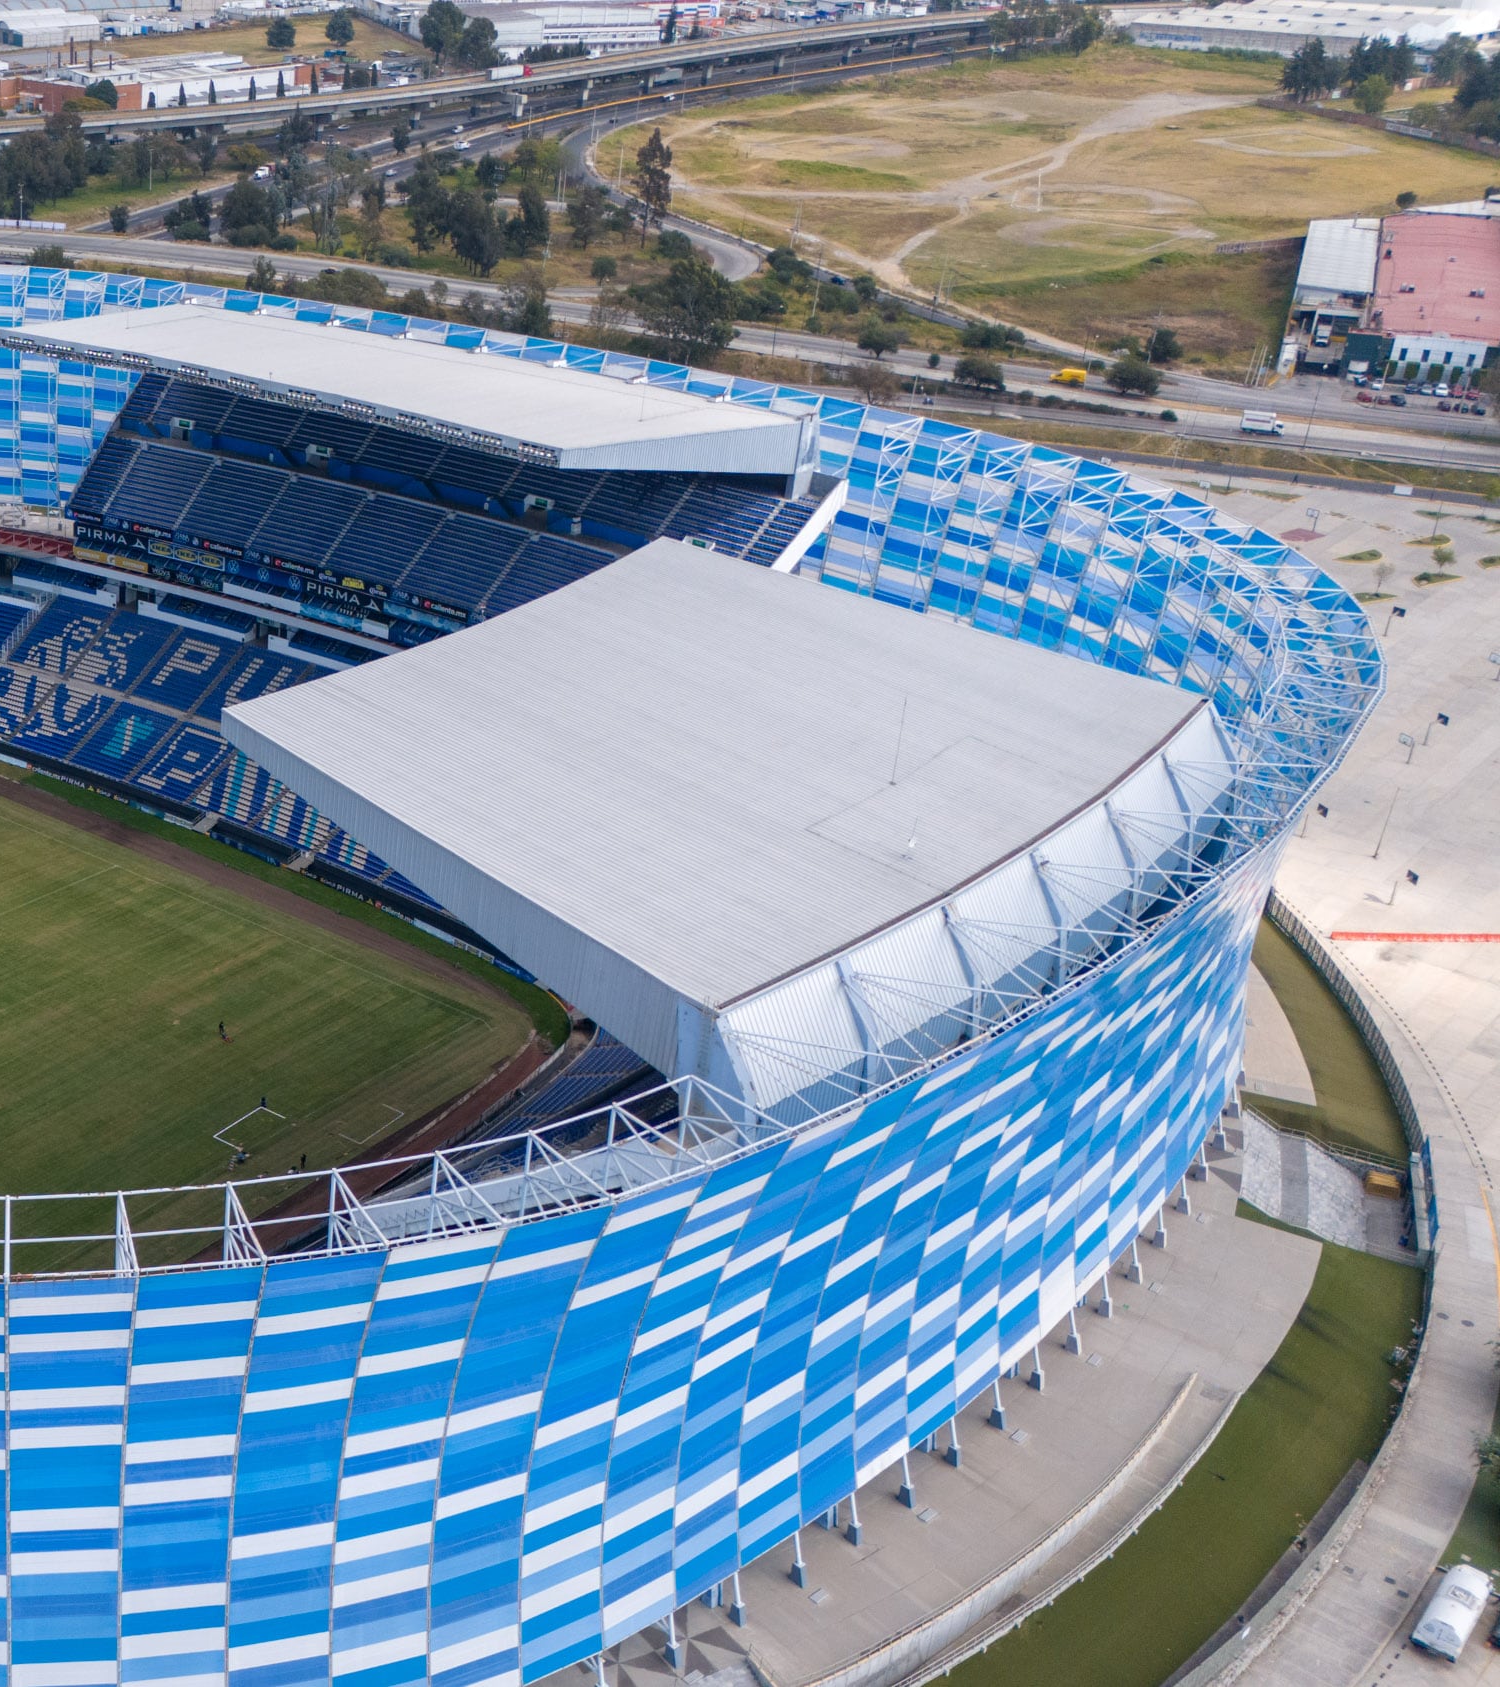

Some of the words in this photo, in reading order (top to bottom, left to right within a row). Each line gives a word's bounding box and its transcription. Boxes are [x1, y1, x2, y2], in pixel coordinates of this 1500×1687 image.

[77, 526, 128, 546] PIRMA
[307, 582, 360, 606] PIRMA
[61, 775, 85, 789] PIRMA
[337, 883, 364, 901] PIRMA
